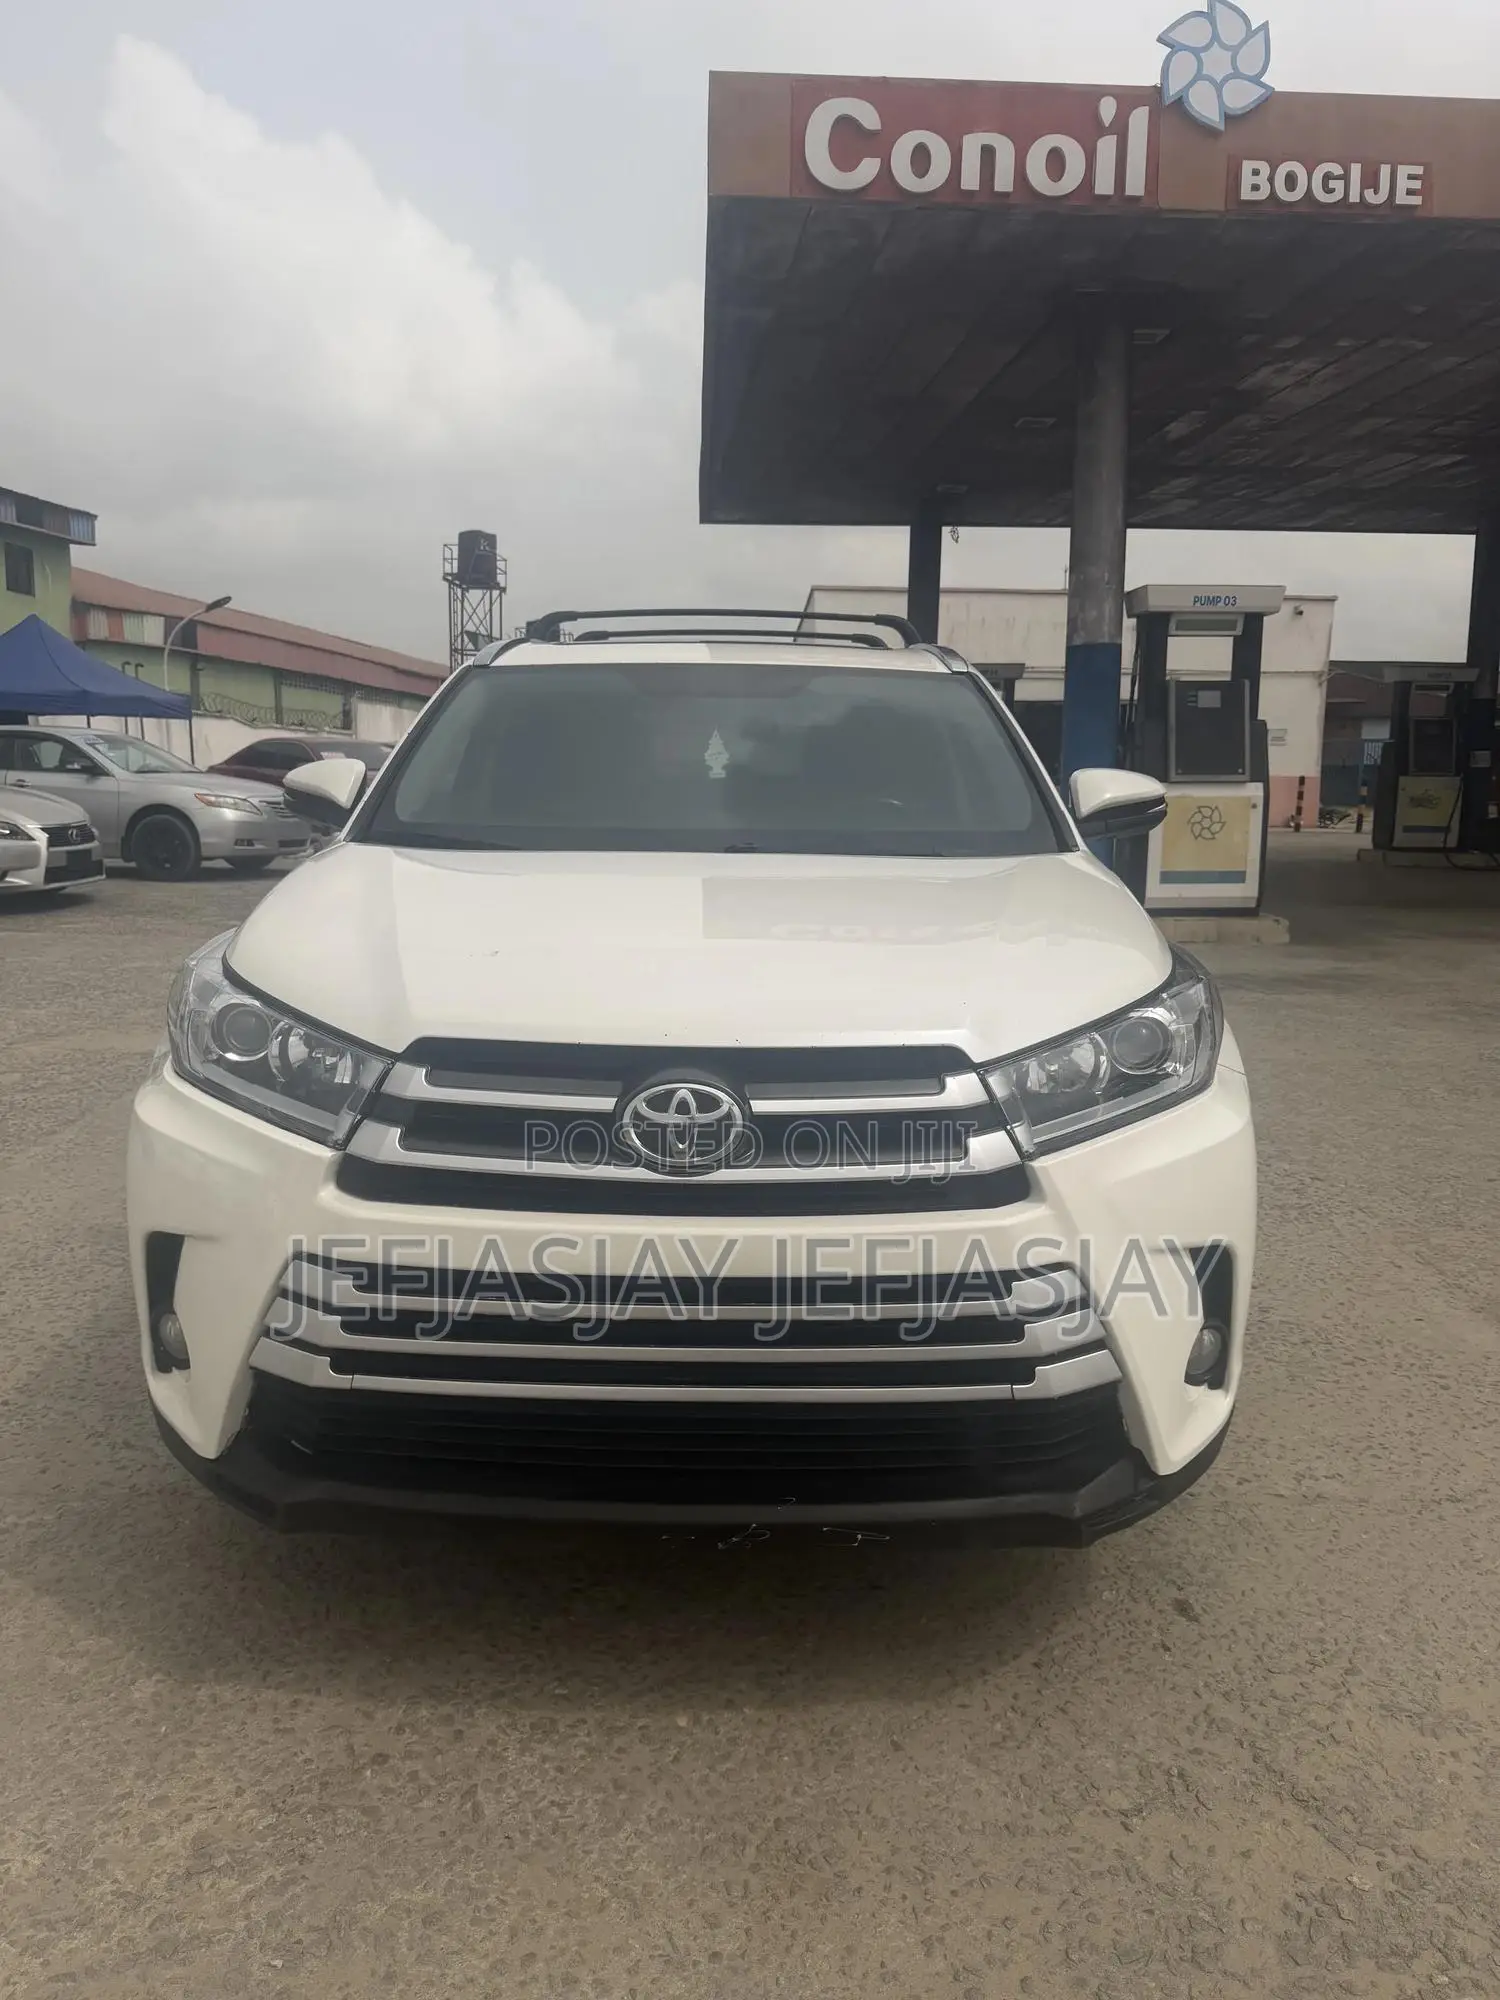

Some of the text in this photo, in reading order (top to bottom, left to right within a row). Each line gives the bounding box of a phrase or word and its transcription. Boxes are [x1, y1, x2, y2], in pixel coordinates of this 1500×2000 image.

[803, 96, 1150, 197] Conoil
[1239, 159, 1424, 206] BOGIJE
[1193, 595, 1238, 607] PUMP 03
